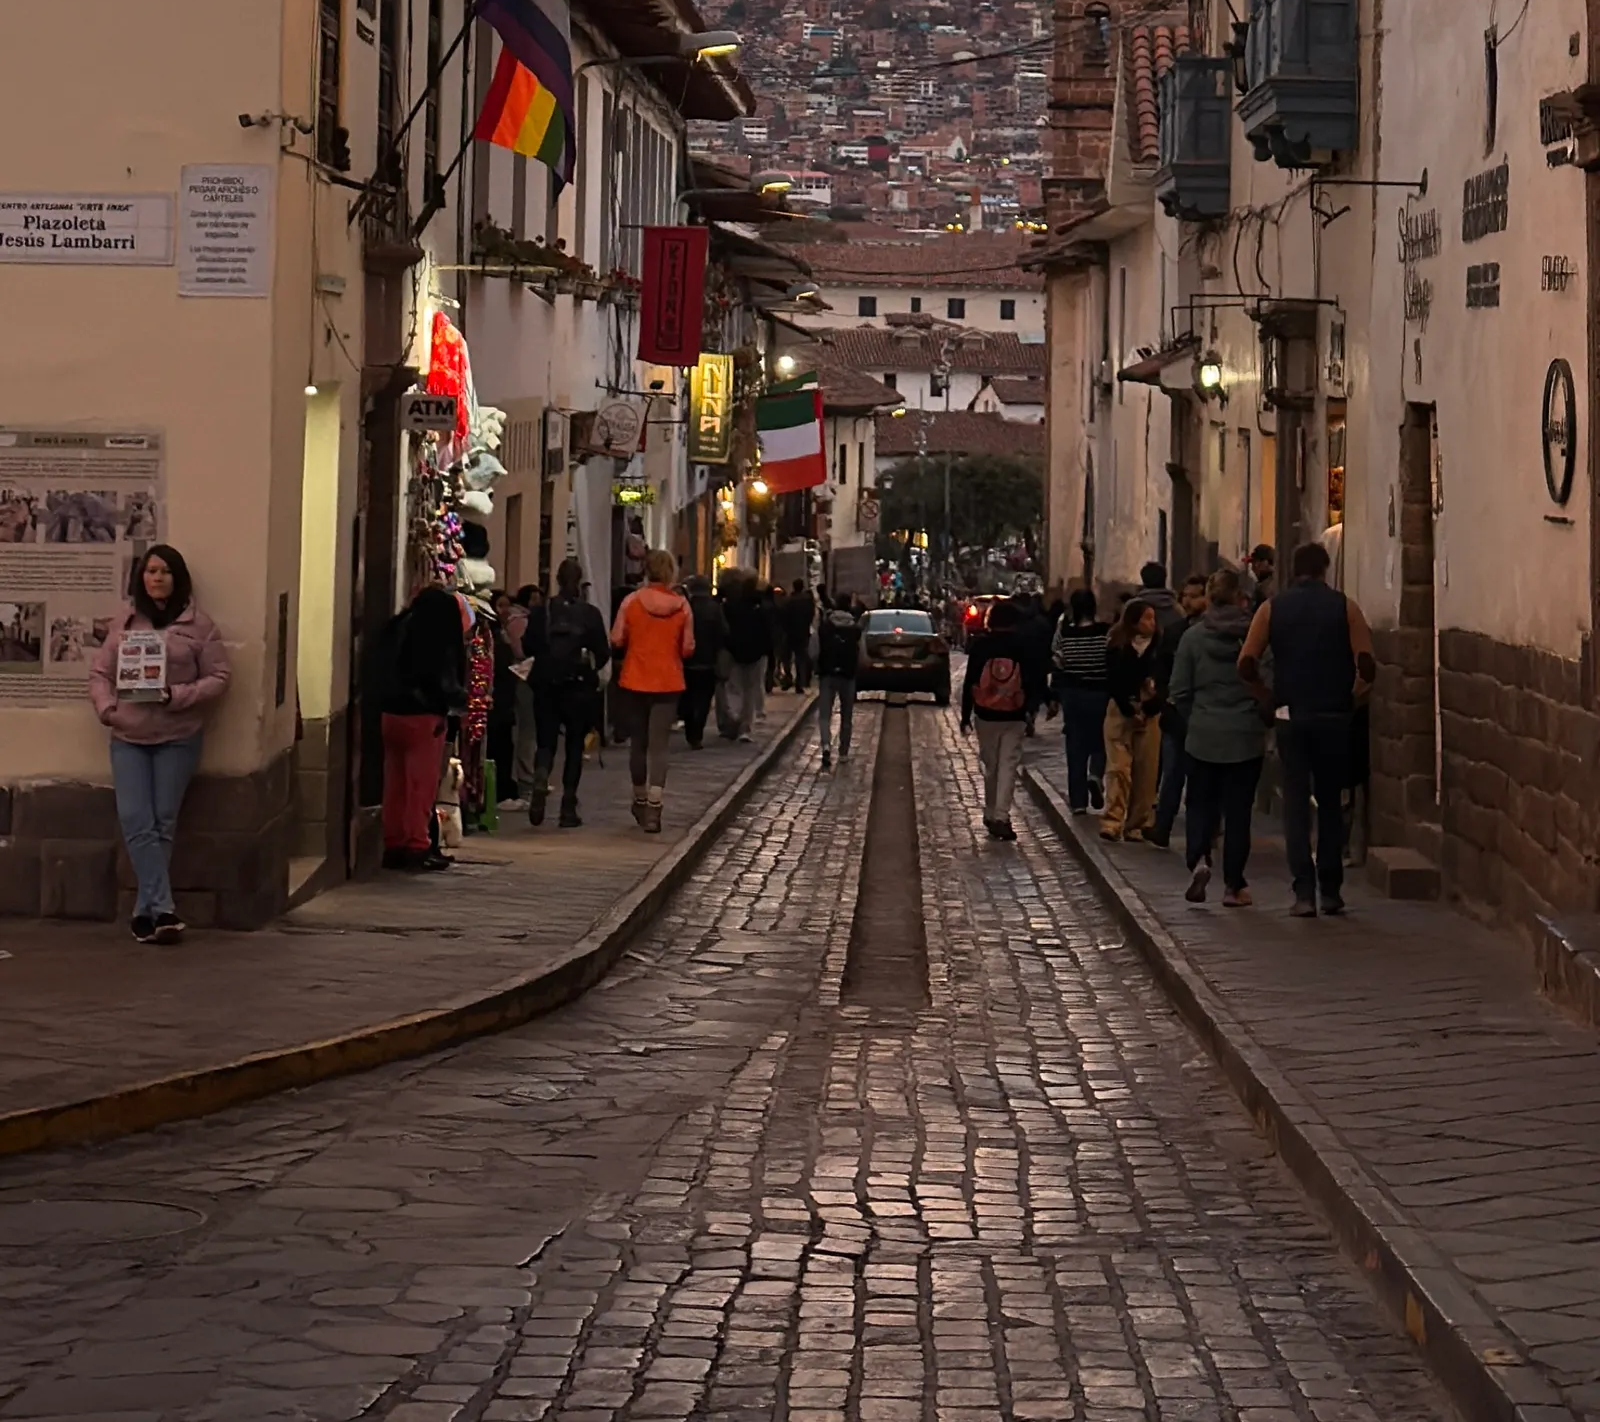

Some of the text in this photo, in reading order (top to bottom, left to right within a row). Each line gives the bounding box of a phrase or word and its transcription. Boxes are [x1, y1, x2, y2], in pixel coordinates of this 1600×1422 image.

[0, 202, 27, 210] ENTRO
[203, 194, 244, 203] CARTELES
[23, 215, 107, 231] Plazoleta
[0, 231, 135, 249] Jesús Lambarri
[408, 399, 454, 415] ATM
